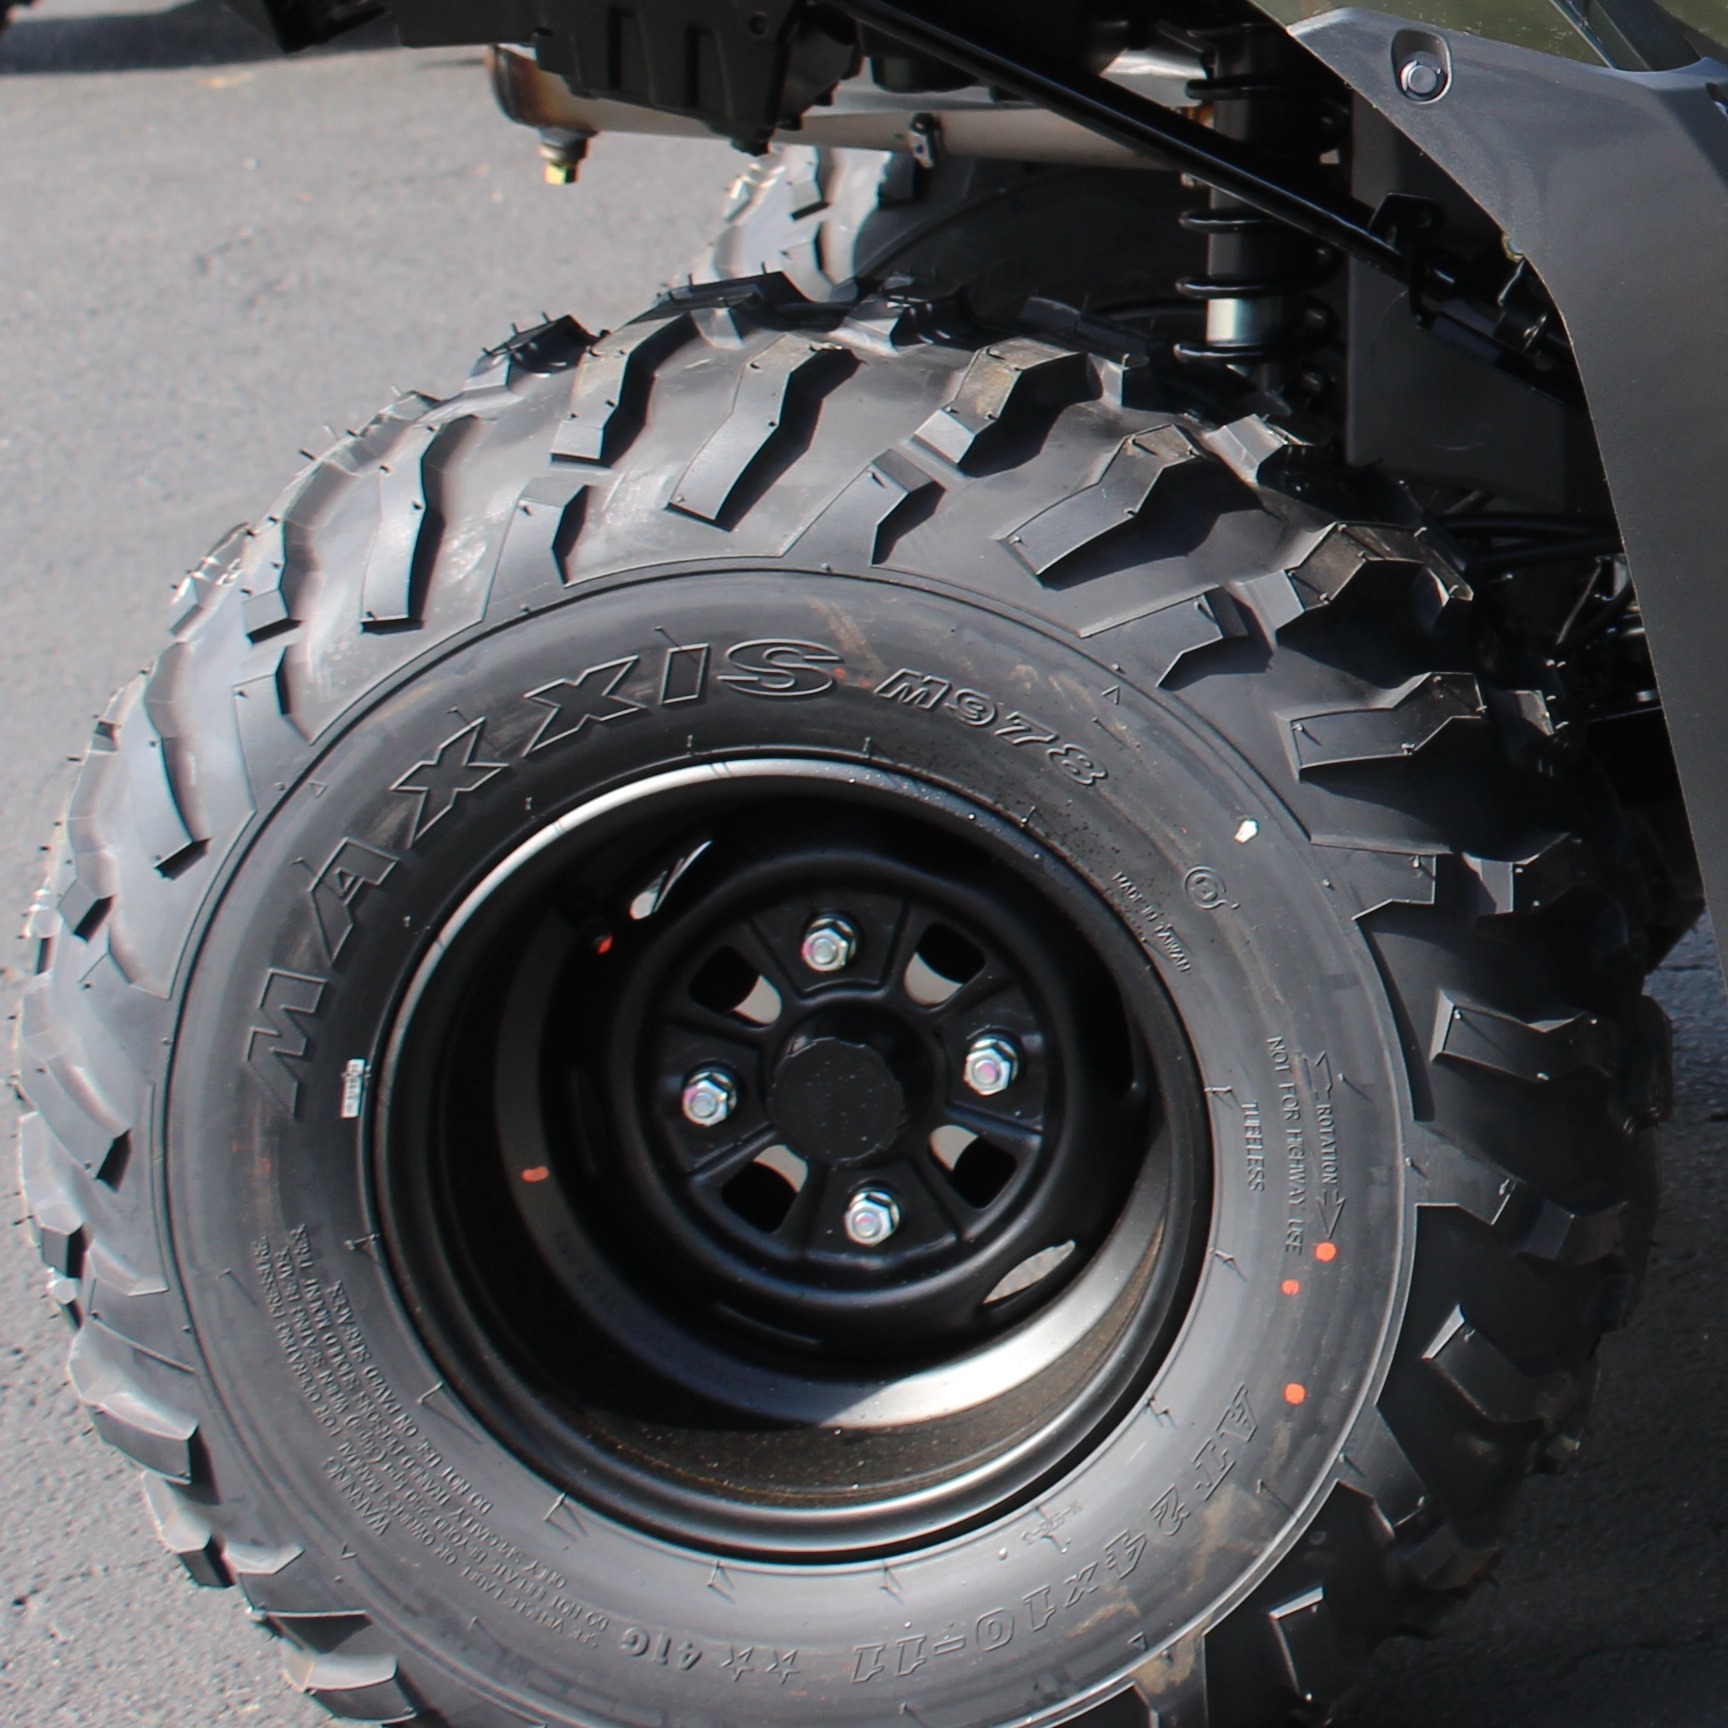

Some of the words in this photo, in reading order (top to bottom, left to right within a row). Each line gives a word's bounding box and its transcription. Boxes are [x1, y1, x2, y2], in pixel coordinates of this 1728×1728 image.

[248, 636, 850, 1118] MAXXIS
[876, 667, 1111, 789] M978
[1111, 870, 1143, 904] MADE
[1138, 903, 1159, 924] IN
[1152, 922, 1193, 974] TAIWAN
[1266, 1035, 1292, 1074] NOT
[1278, 1082, 1299, 1119] FOR
[1240, 1101, 1264, 1191] TUBELESS
[1283, 1129, 1305, 1207] HIGHWAY
[1315, 1104, 1336, 1184] ROTATION
[1281, 1217, 1305, 1256] USE
[320, 1454, 392, 1535] WARNING
[619, 1628, 705, 1670] 41G
